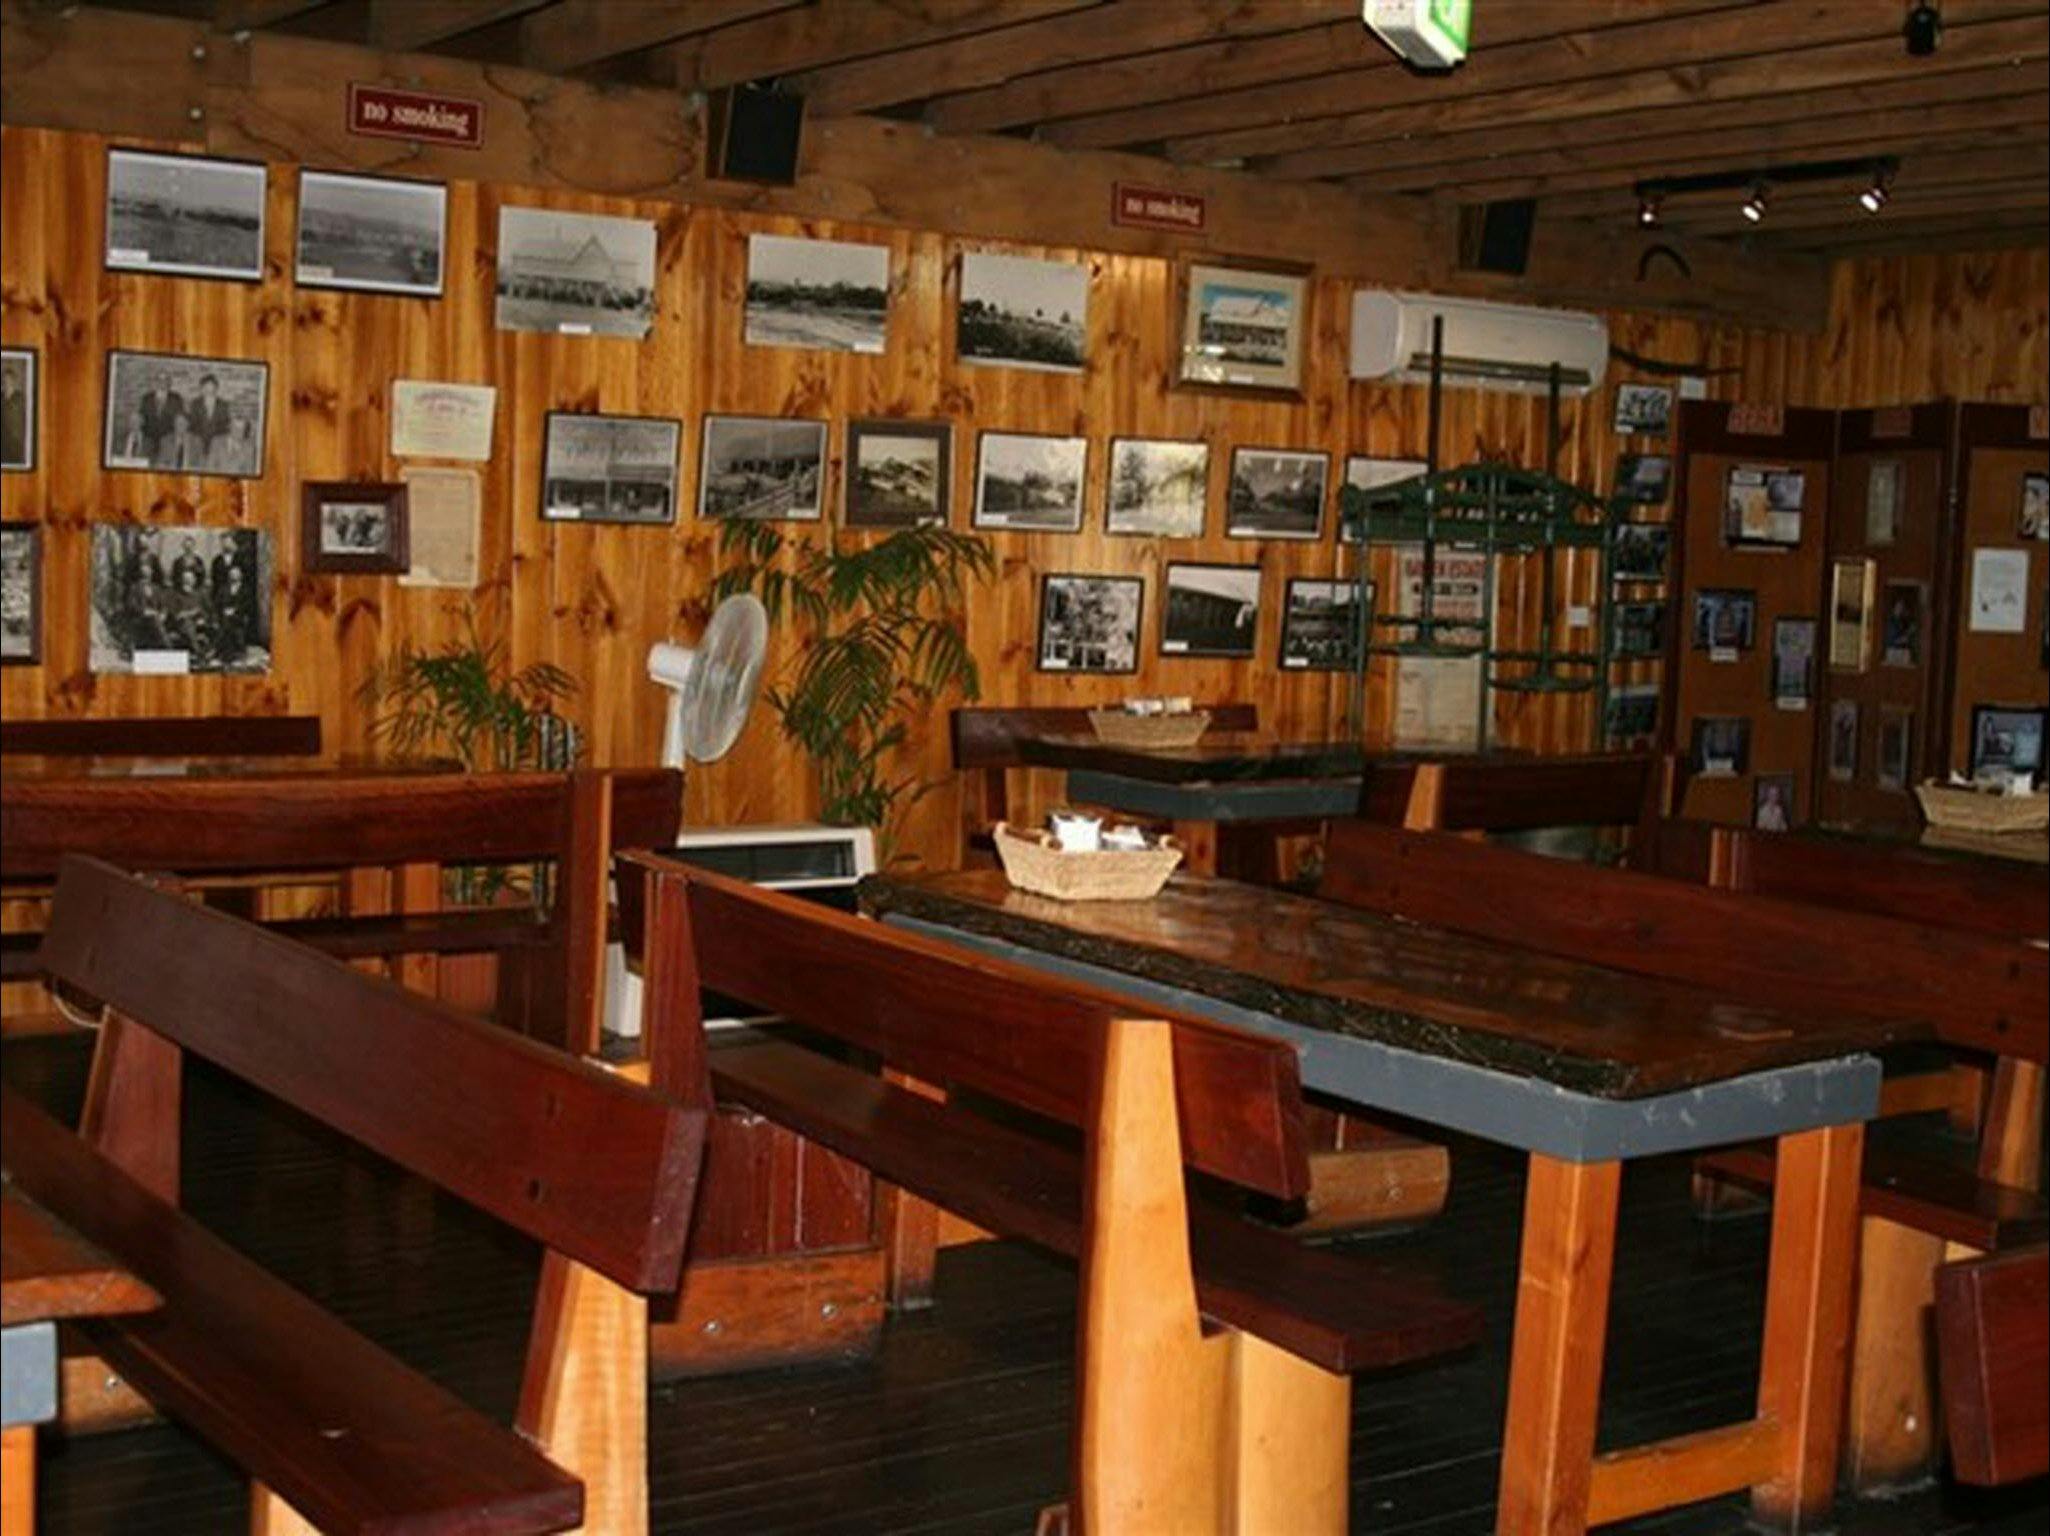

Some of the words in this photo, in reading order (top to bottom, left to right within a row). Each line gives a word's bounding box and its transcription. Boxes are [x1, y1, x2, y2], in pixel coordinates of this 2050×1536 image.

[363, 101, 388, 122] no
[393, 104, 469, 137] smoking
[1126, 198, 1144, 214] no
[1146, 197, 1200, 225] smoking
